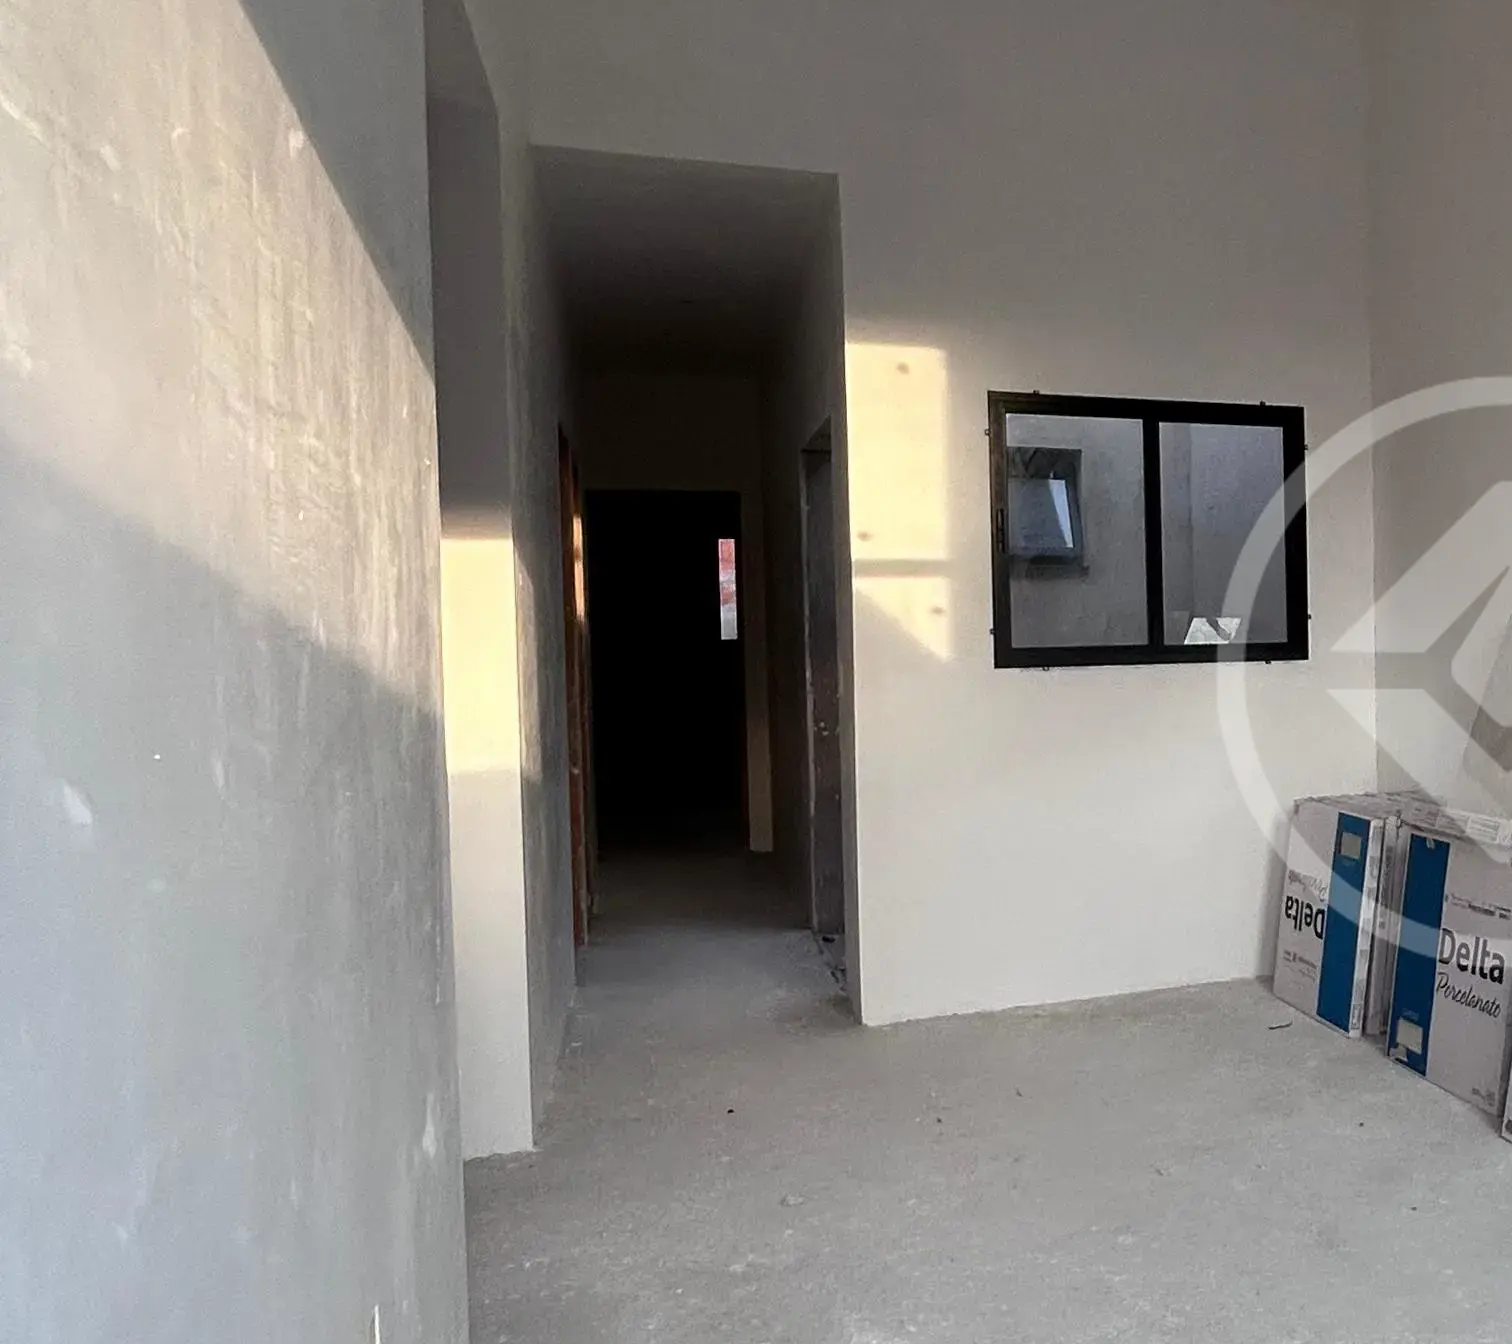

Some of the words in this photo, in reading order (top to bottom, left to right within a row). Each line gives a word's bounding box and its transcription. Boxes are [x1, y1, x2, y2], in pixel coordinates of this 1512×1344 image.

[1284, 895, 1327, 940] Delta
[1438, 927, 1505, 985] Delta
[1436, 971, 1501, 1018] Porcelanato
